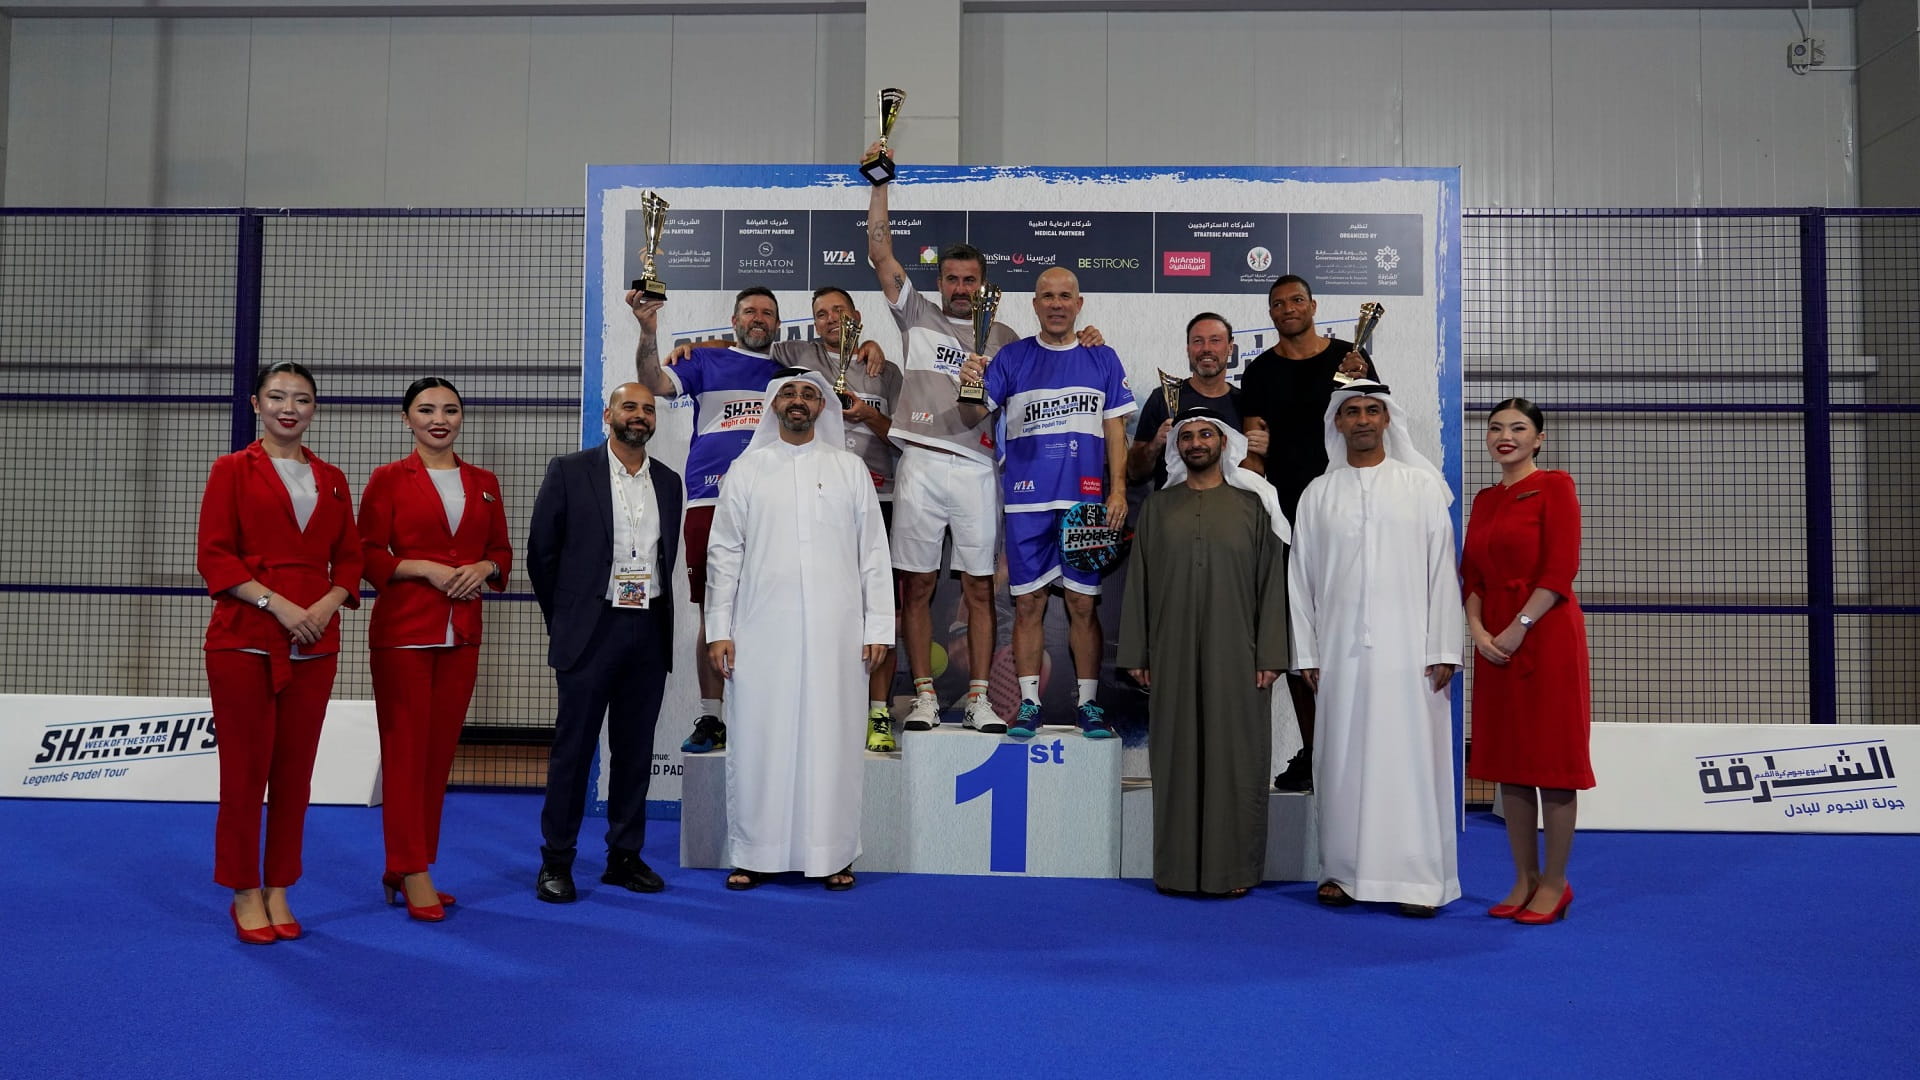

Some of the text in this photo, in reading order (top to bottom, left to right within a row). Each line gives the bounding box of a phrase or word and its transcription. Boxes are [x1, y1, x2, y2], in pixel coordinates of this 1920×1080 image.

[897, 219, 922, 227] الشركاء
[738, 259, 794, 268] SHERATON
[1078, 258, 1140, 269] BE STRONG
[1169, 256, 1206, 264] AirArabia
[1024, 395, 1099, 423] SHARJAH'S
[35, 717, 218, 763] SHARJAH'S
[140, 734, 168, 743] STARS
[22, 768, 130, 787] Legends Padel Tour
[1784, 797, 1905, 817] جولة النجوم للبادل
